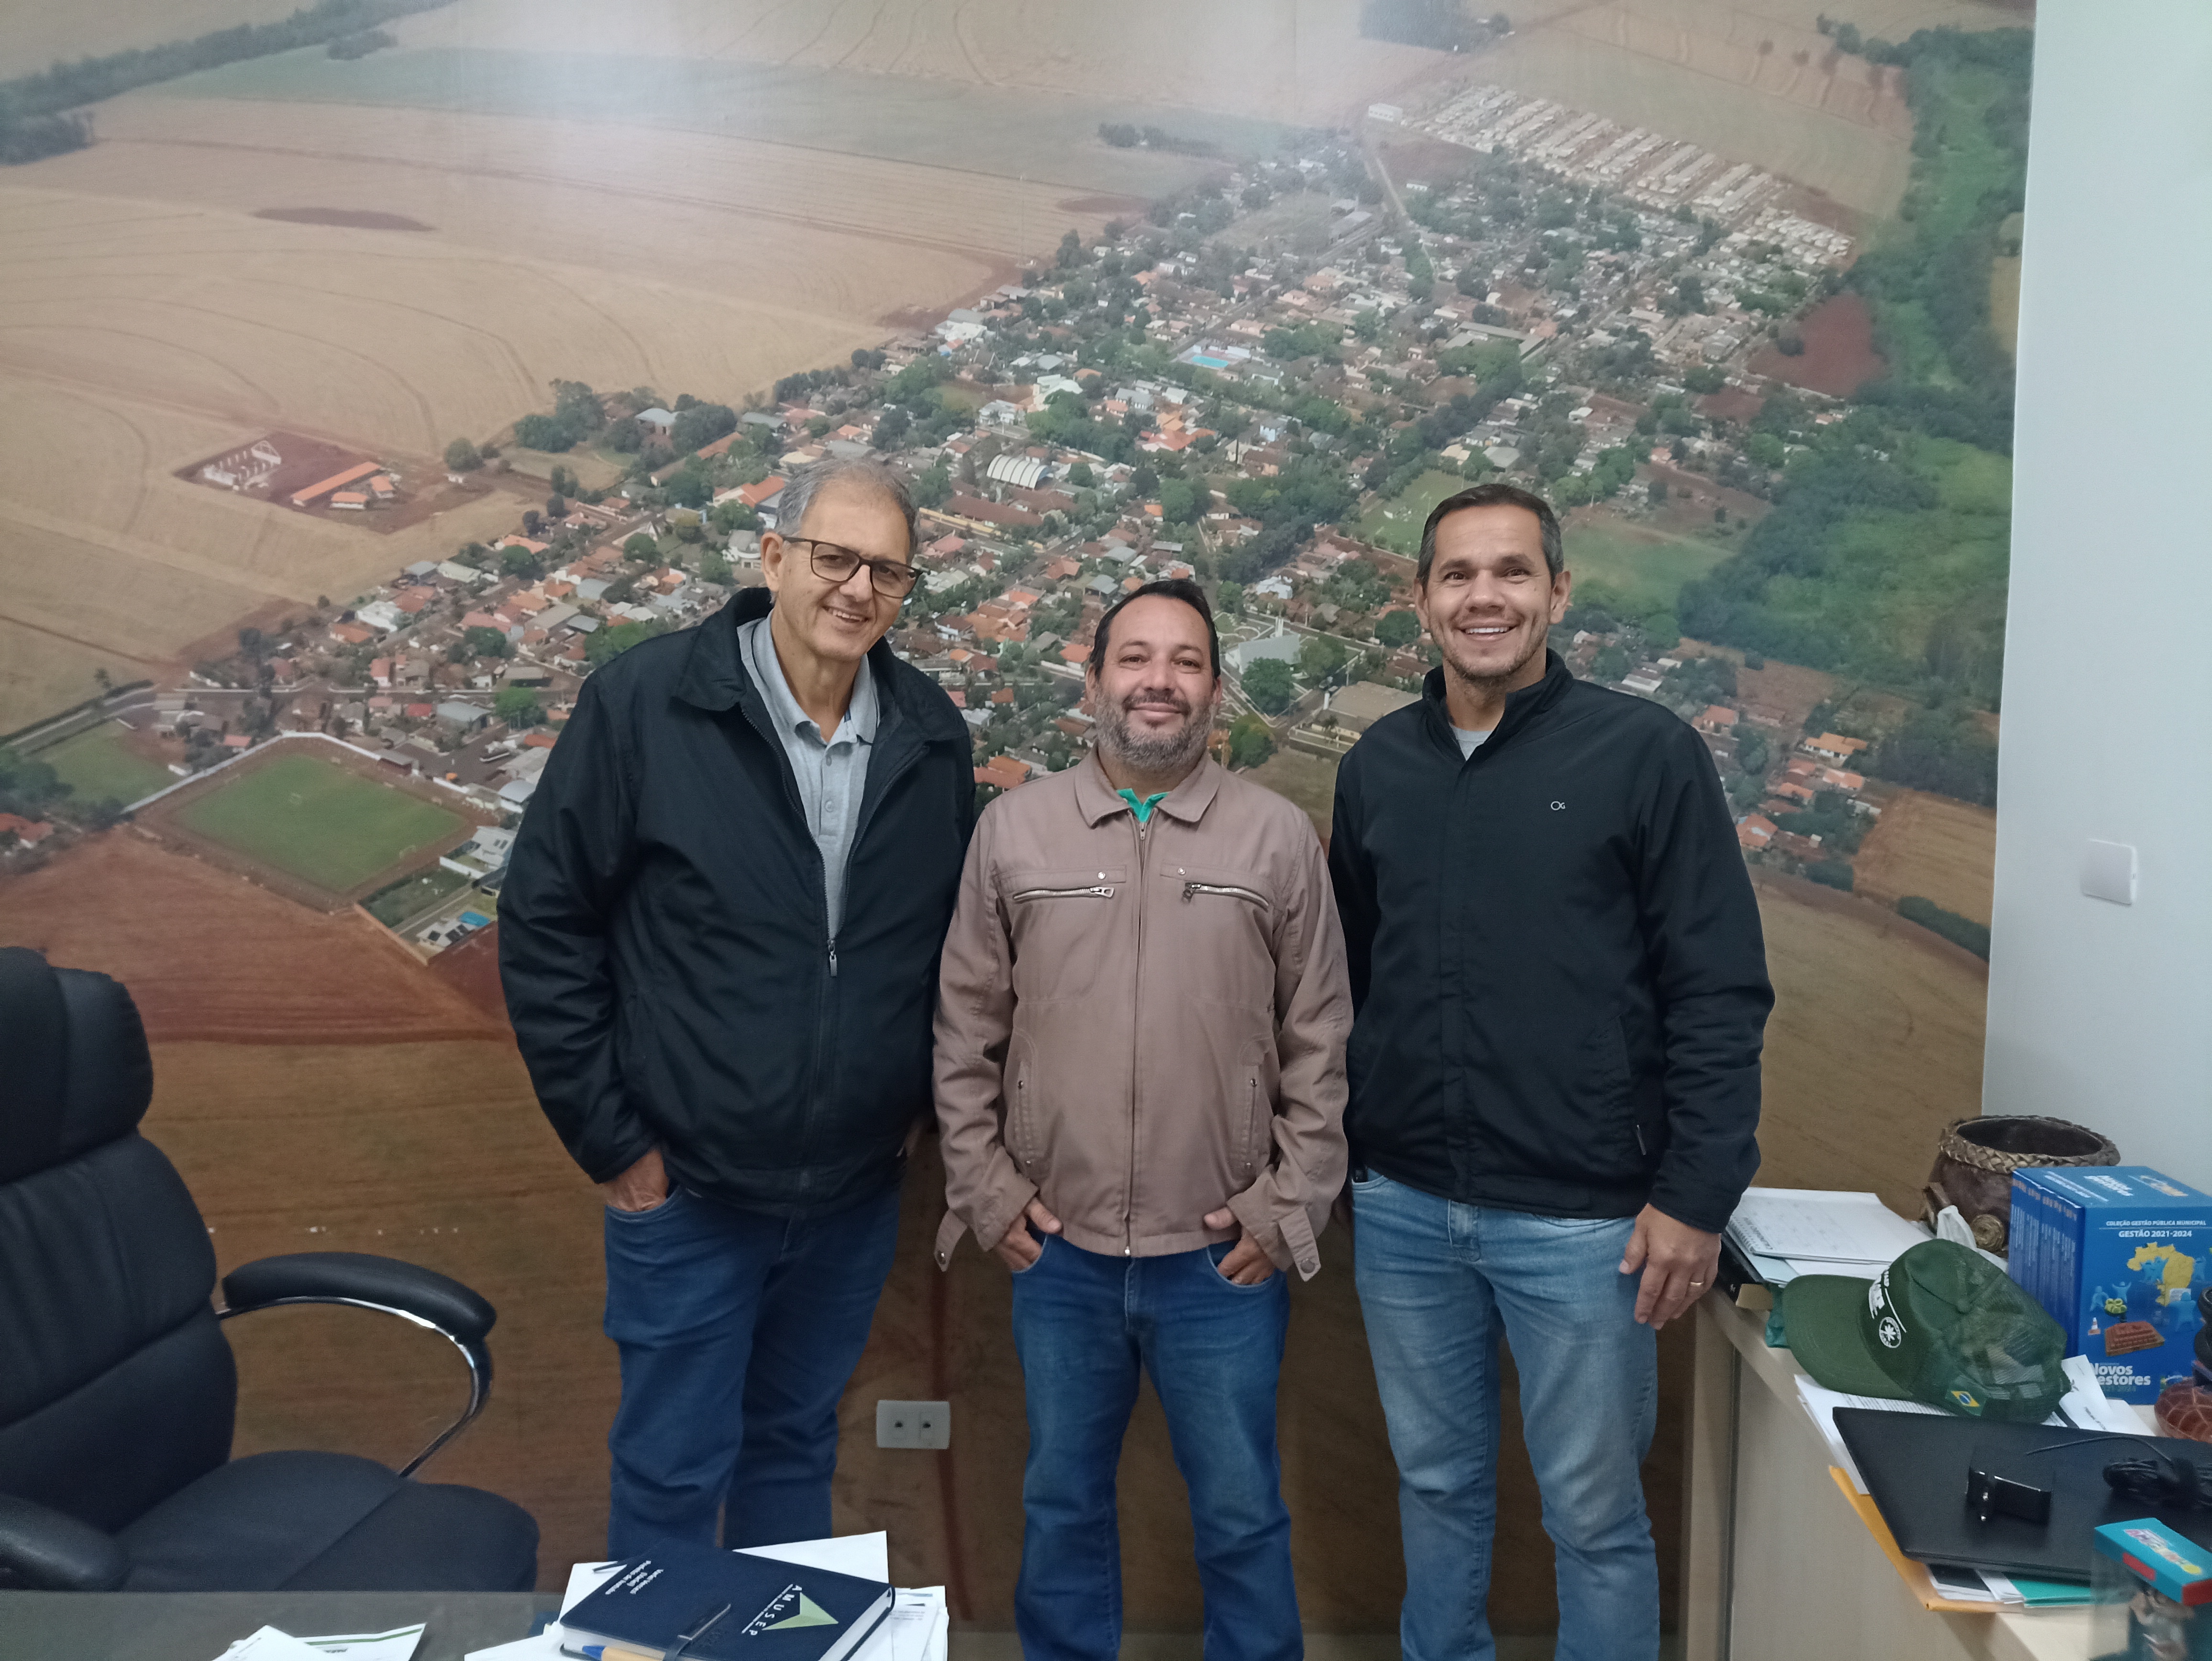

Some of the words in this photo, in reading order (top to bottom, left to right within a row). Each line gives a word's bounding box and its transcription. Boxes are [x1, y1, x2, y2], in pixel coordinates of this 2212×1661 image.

[2118, 1229, 2150, 1237] GESTÃO
[2097, 1374, 2151, 1385] estores
[749, 1584, 803, 1636] AMUSEP
